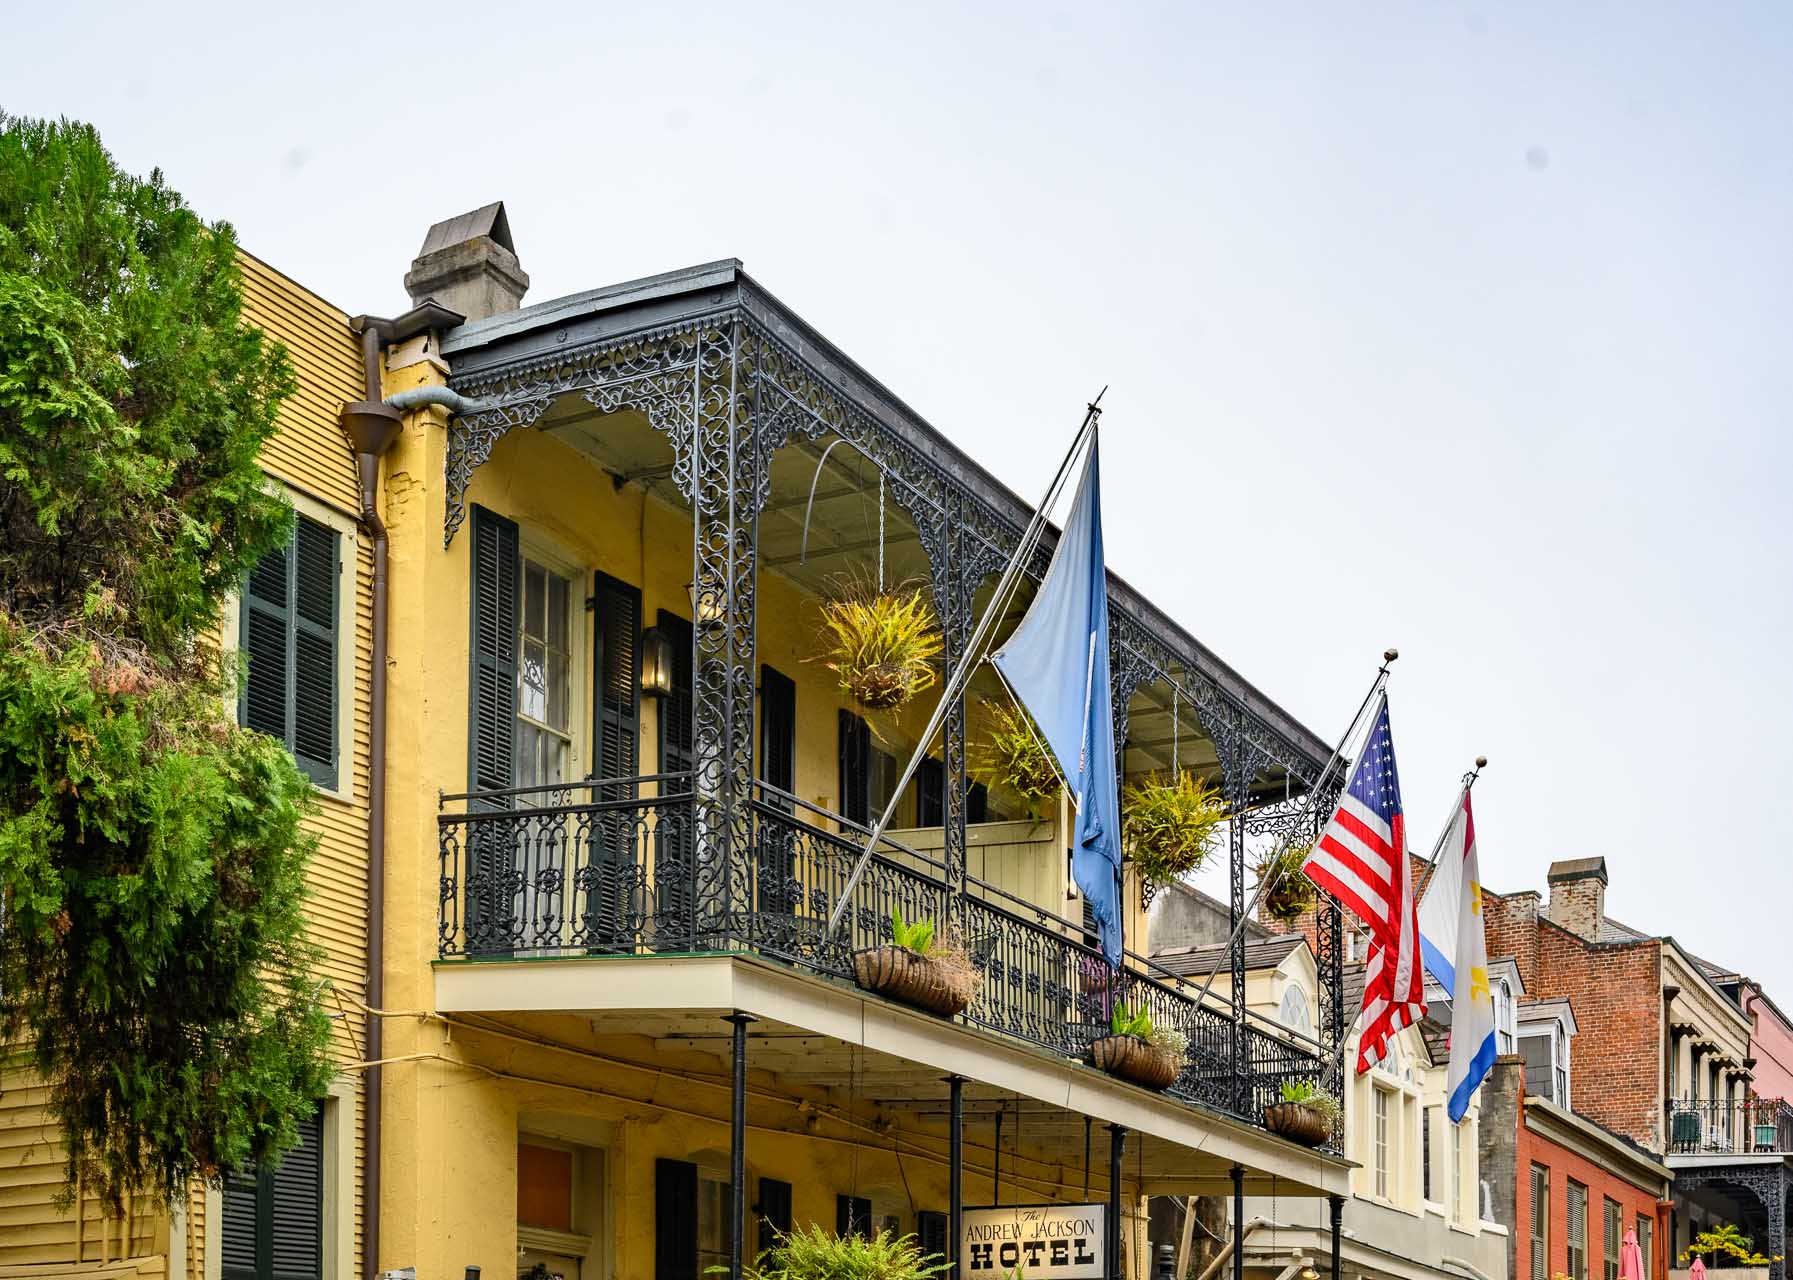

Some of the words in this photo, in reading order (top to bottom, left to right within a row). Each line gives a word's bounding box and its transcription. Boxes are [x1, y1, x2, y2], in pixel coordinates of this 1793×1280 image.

[1022, 1209, 1040, 1222] The
[966, 1223, 1023, 1241] ANDREW
[1031, 1219, 1094, 1239] JACKSON
[970, 1238, 1095, 1270] HOTEL
